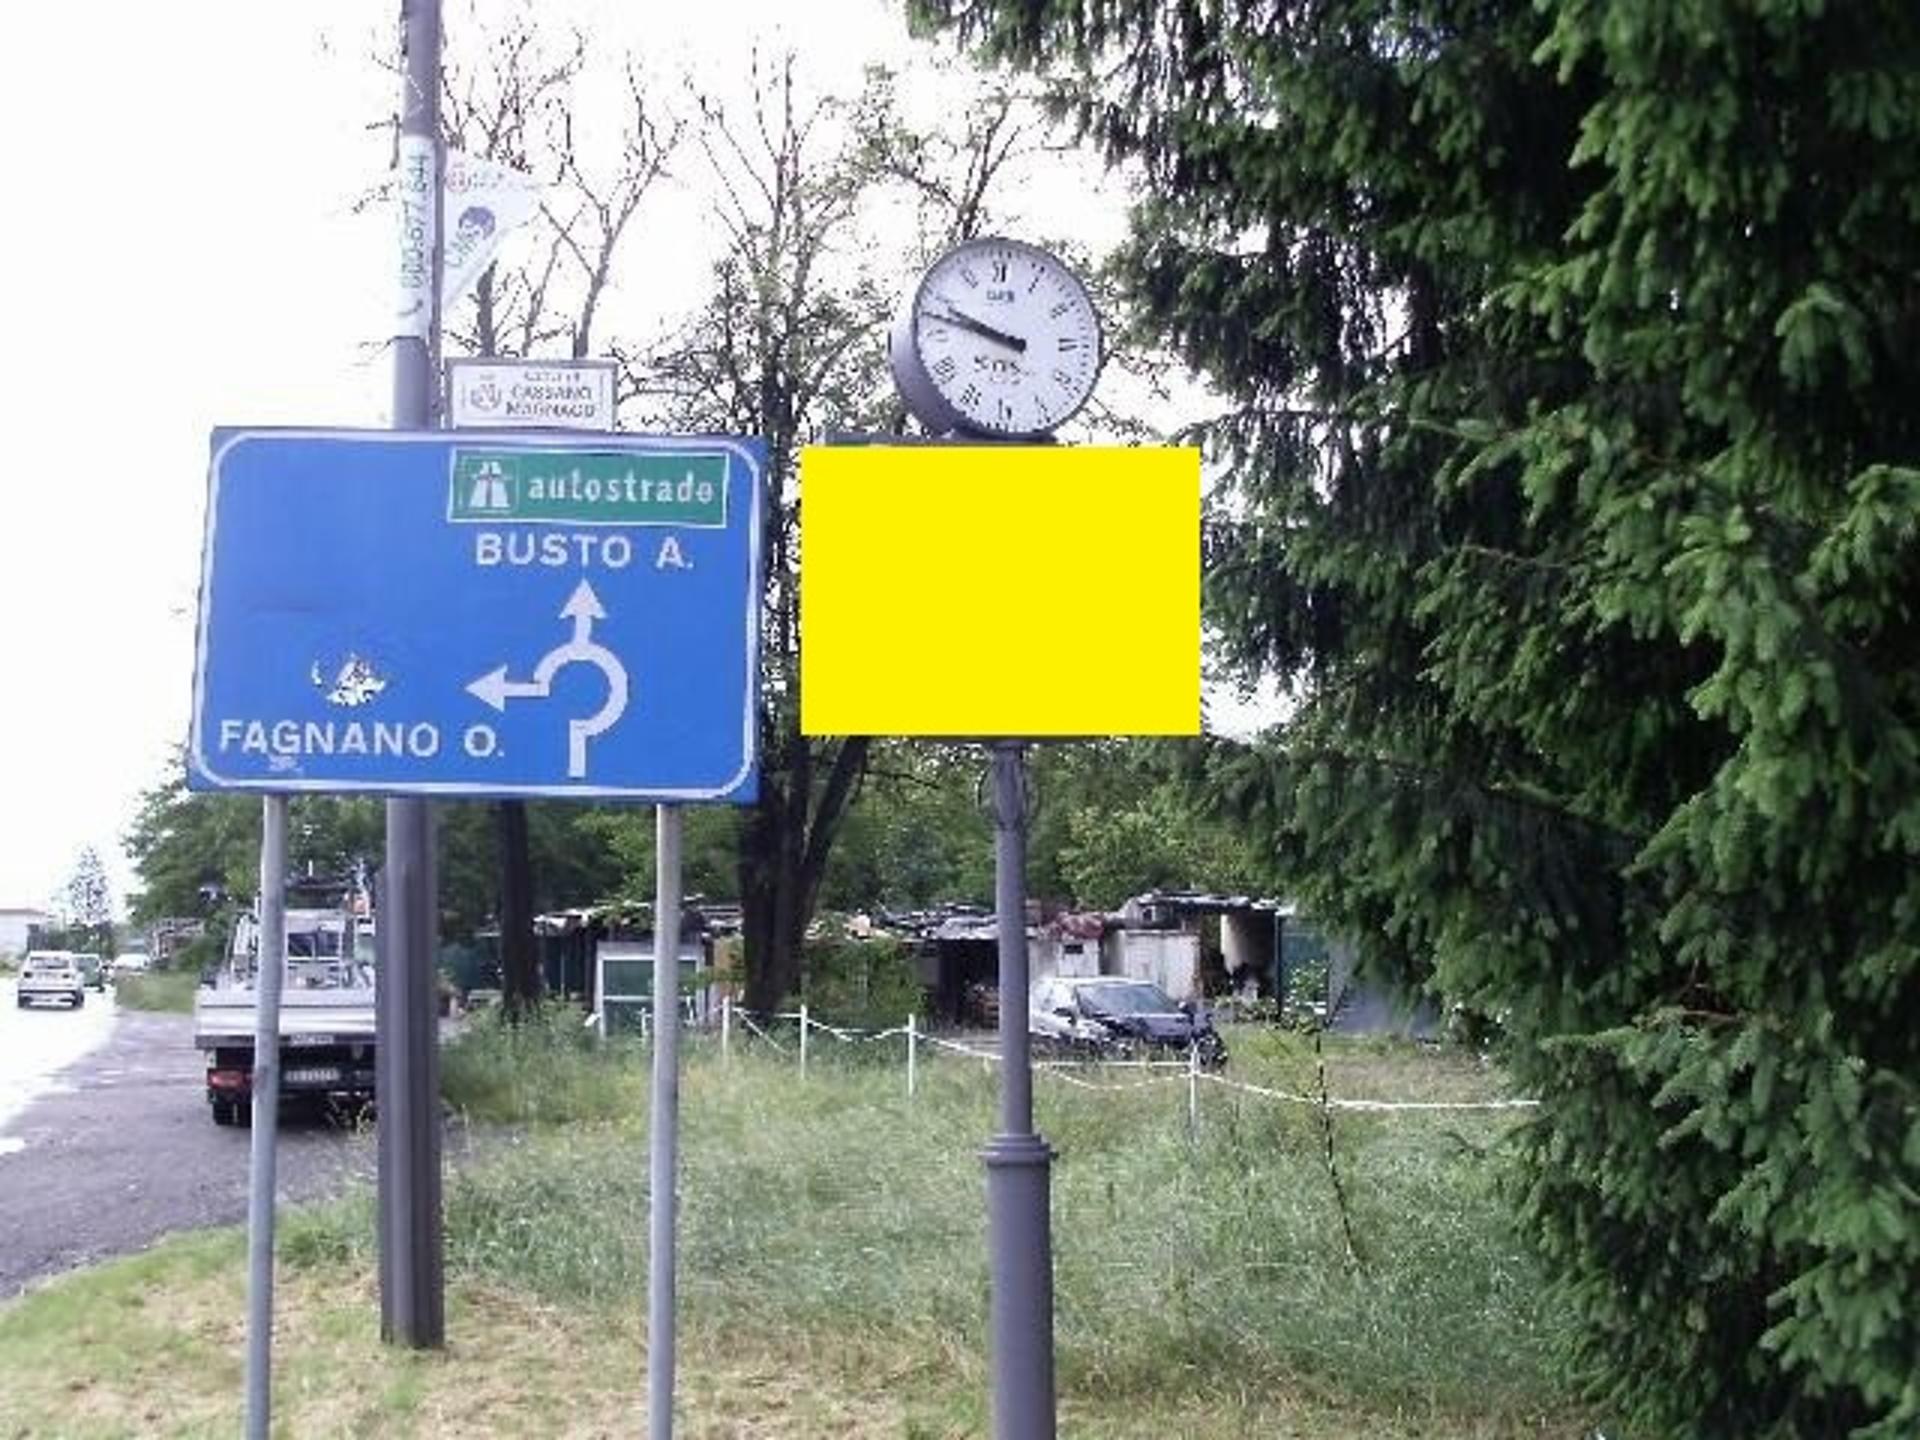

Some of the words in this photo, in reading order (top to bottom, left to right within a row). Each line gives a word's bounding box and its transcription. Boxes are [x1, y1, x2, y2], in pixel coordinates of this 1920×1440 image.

[527, 467, 714, 503] autostrade
[475, 532, 631, 569] BUSTO
[655, 535, 694, 569] A.
[218, 718, 440, 758] FAGNANO
[463, 723, 505, 758] O.
